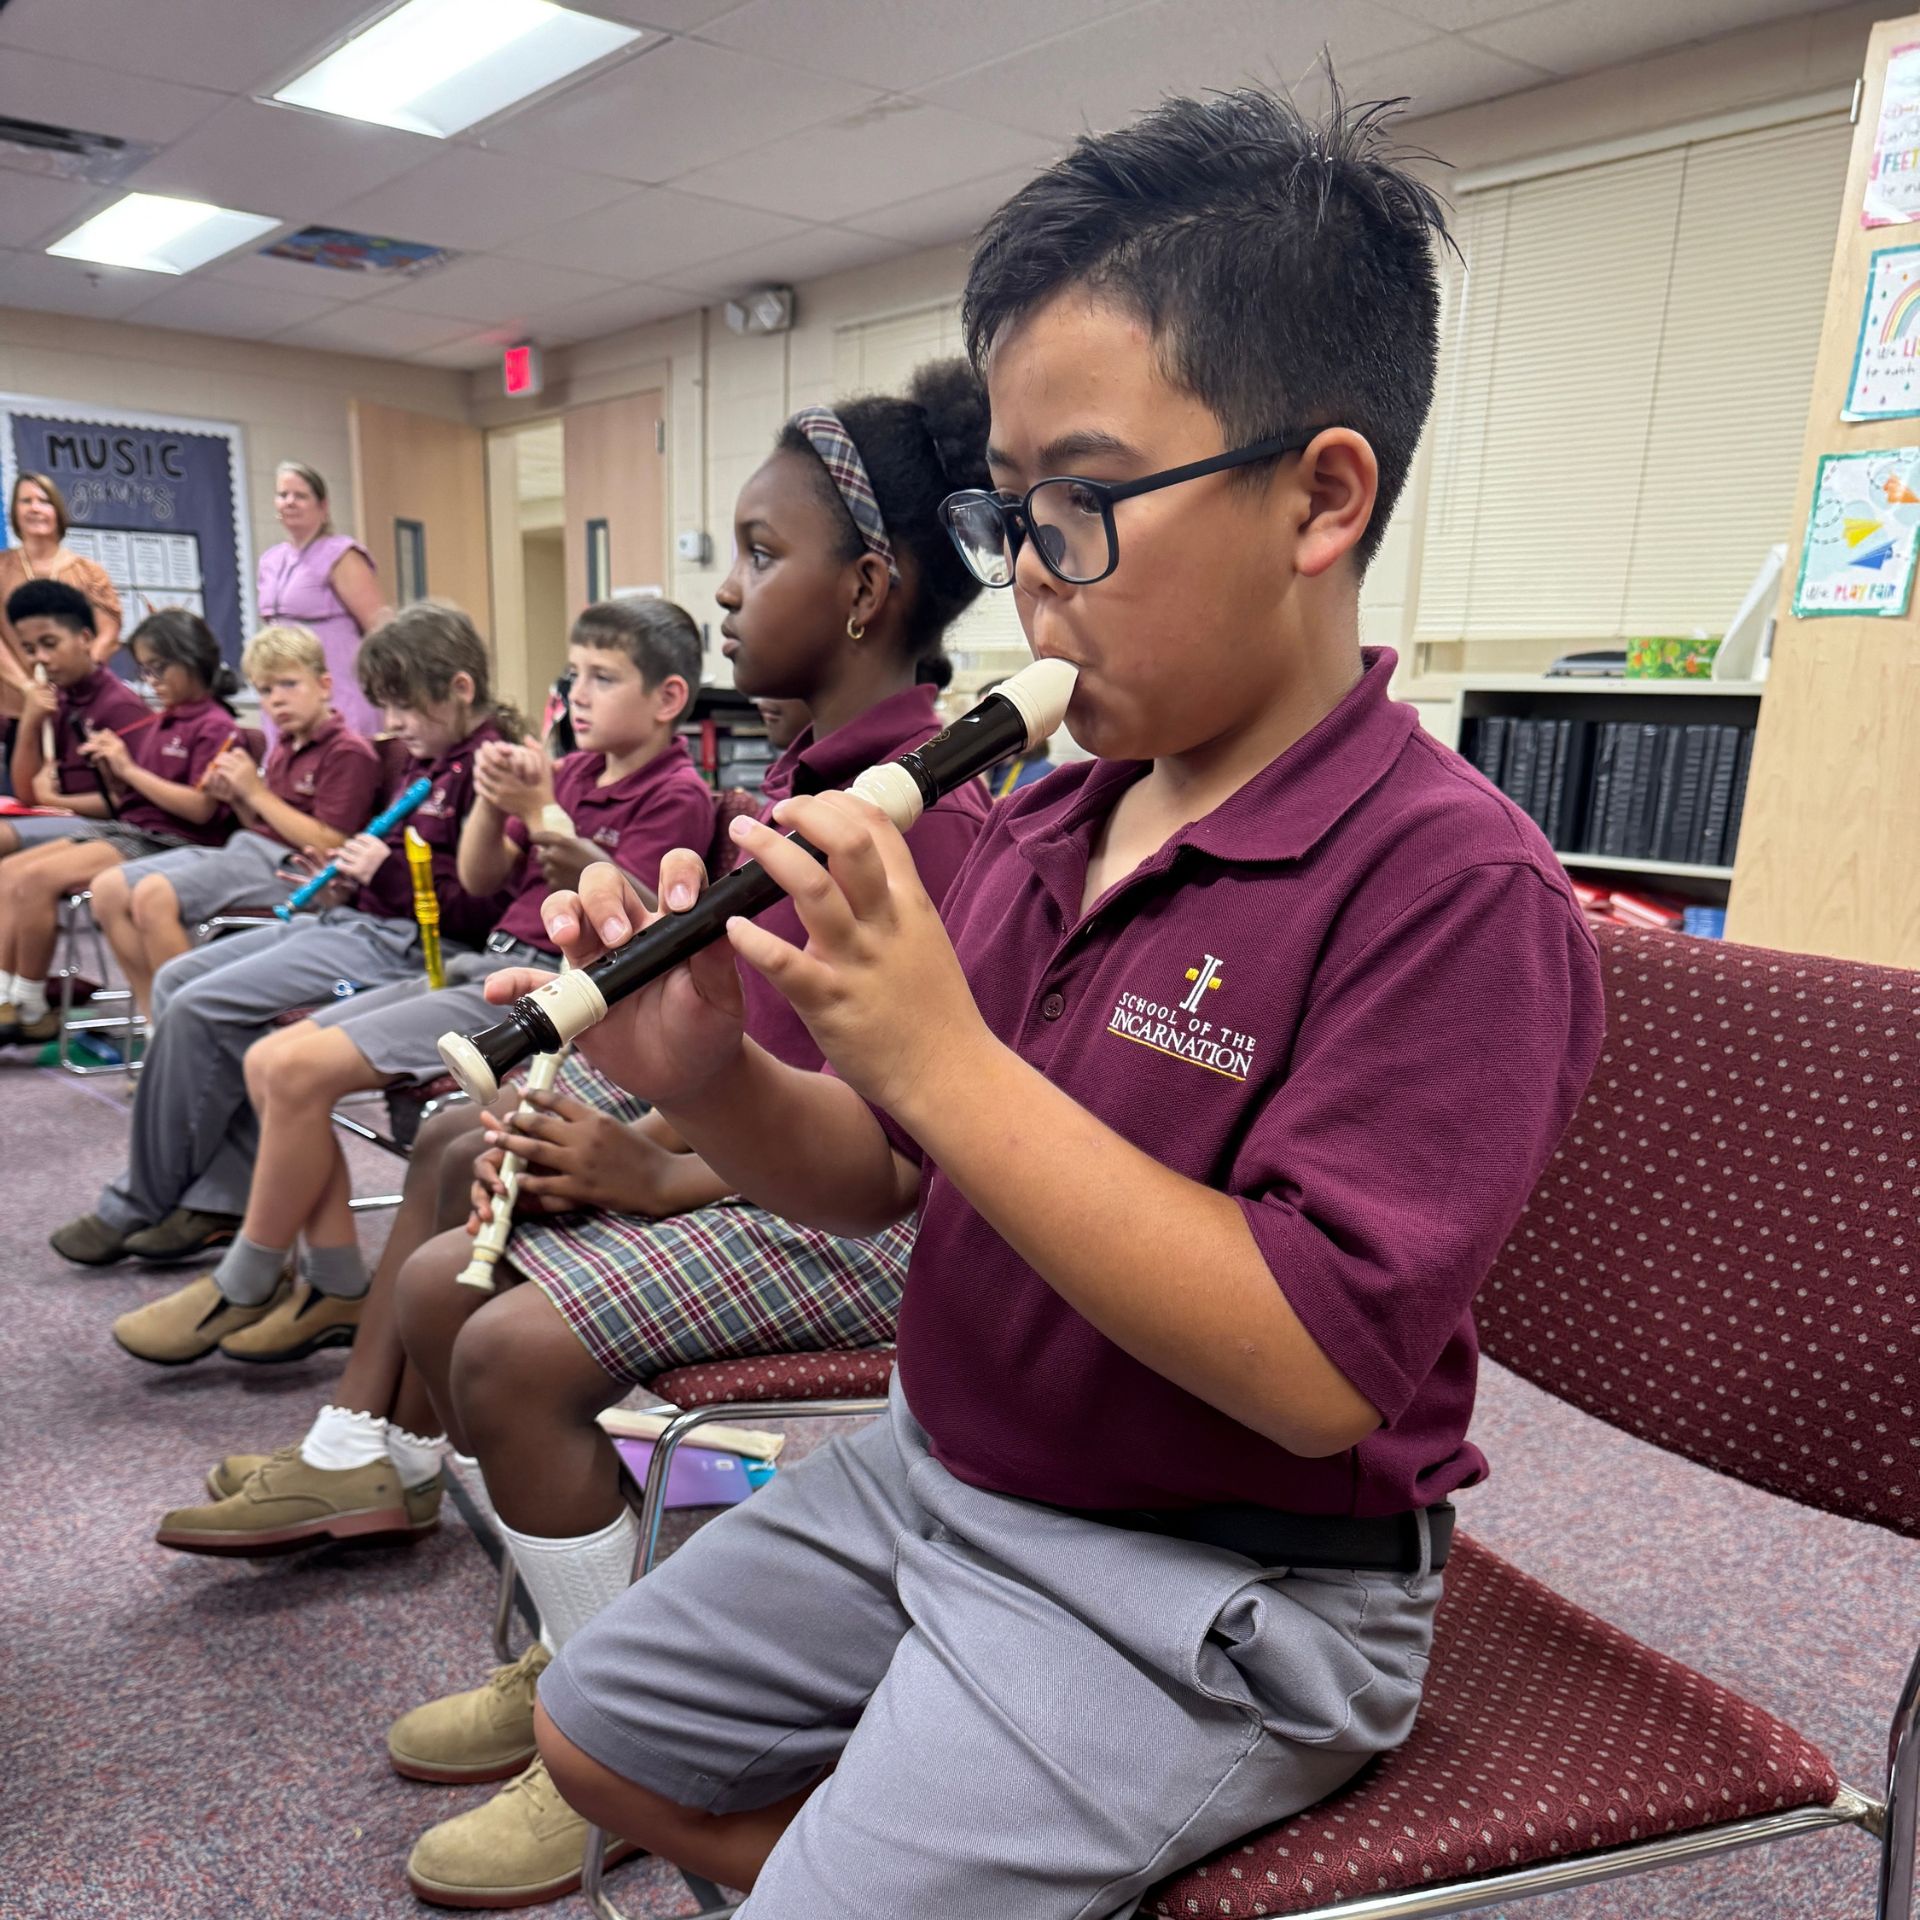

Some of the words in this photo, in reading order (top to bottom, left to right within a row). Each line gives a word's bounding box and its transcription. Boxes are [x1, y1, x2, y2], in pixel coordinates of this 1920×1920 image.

[1882, 147, 1920, 175] FEET
[46, 434, 184, 478] MUSIC
[1109, 1006, 1254, 1077] INCARNATION
[1118, 991, 1178, 1026] SCHOOL
[1188, 1018, 1213, 1037] OF
[1220, 1027, 1257, 1053] THE
